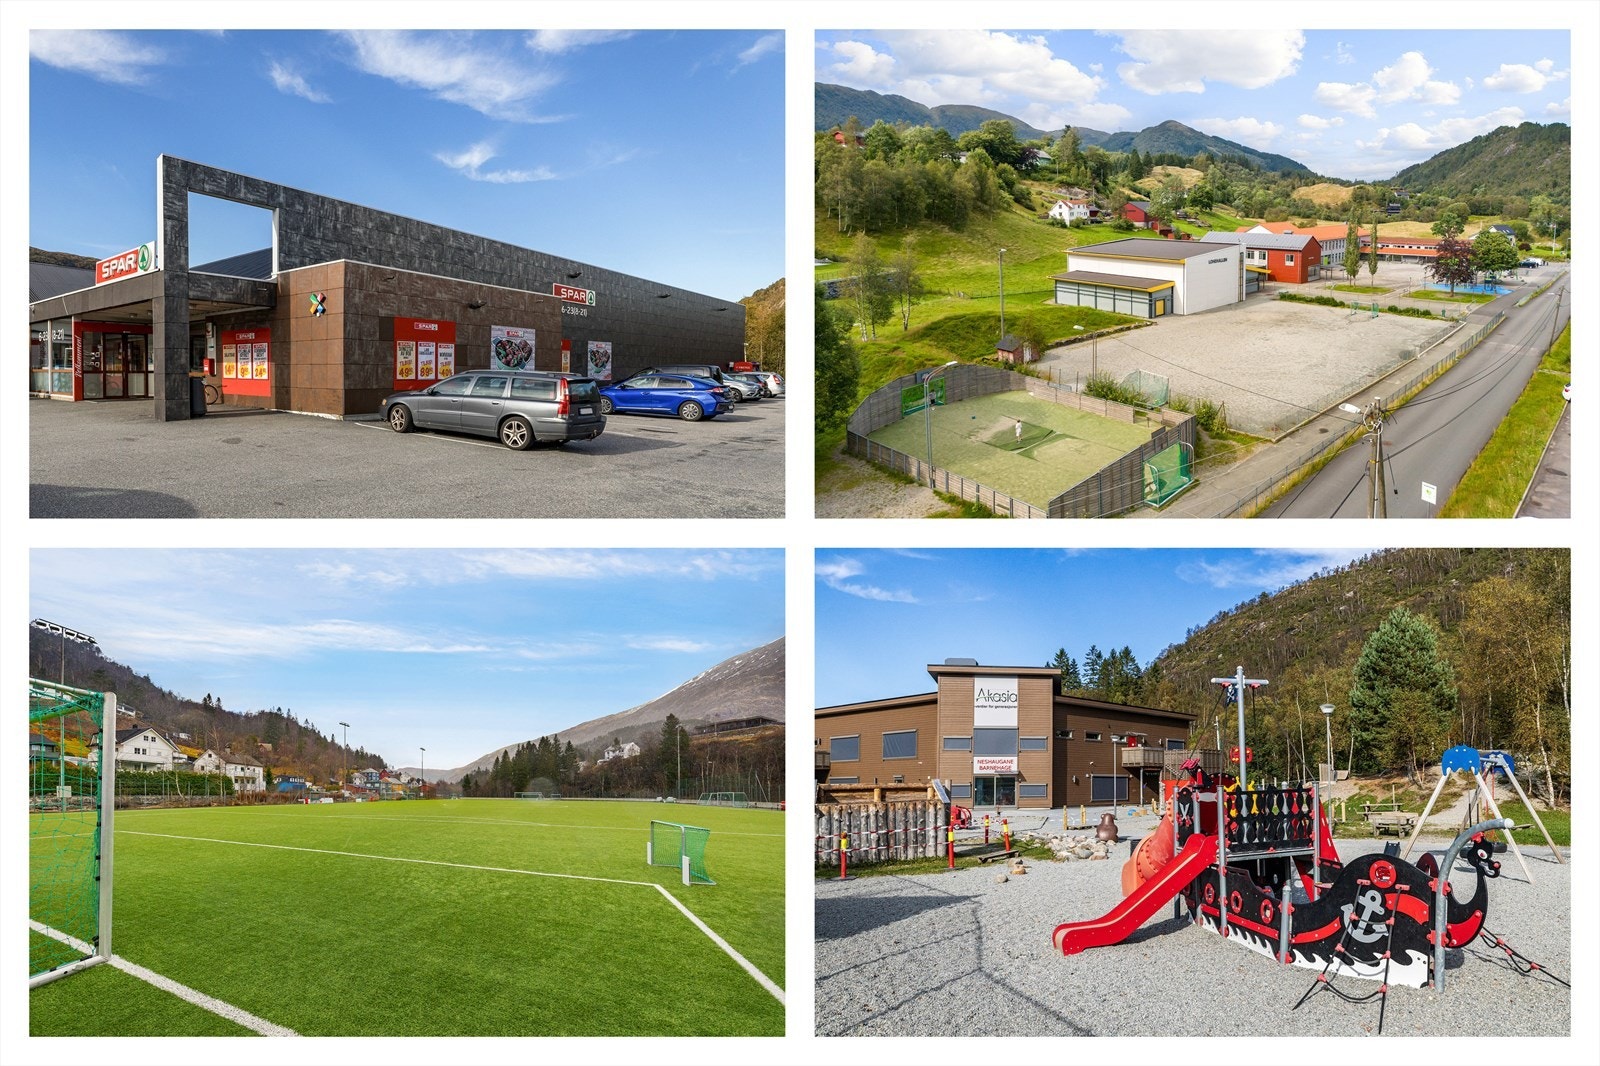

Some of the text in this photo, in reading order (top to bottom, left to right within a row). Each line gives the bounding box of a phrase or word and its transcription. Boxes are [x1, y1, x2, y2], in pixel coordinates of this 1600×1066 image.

[101, 253, 137, 279] SPAR
[560, 288, 586, 301] SPAR
[976, 687, 1018, 703] Akasia
